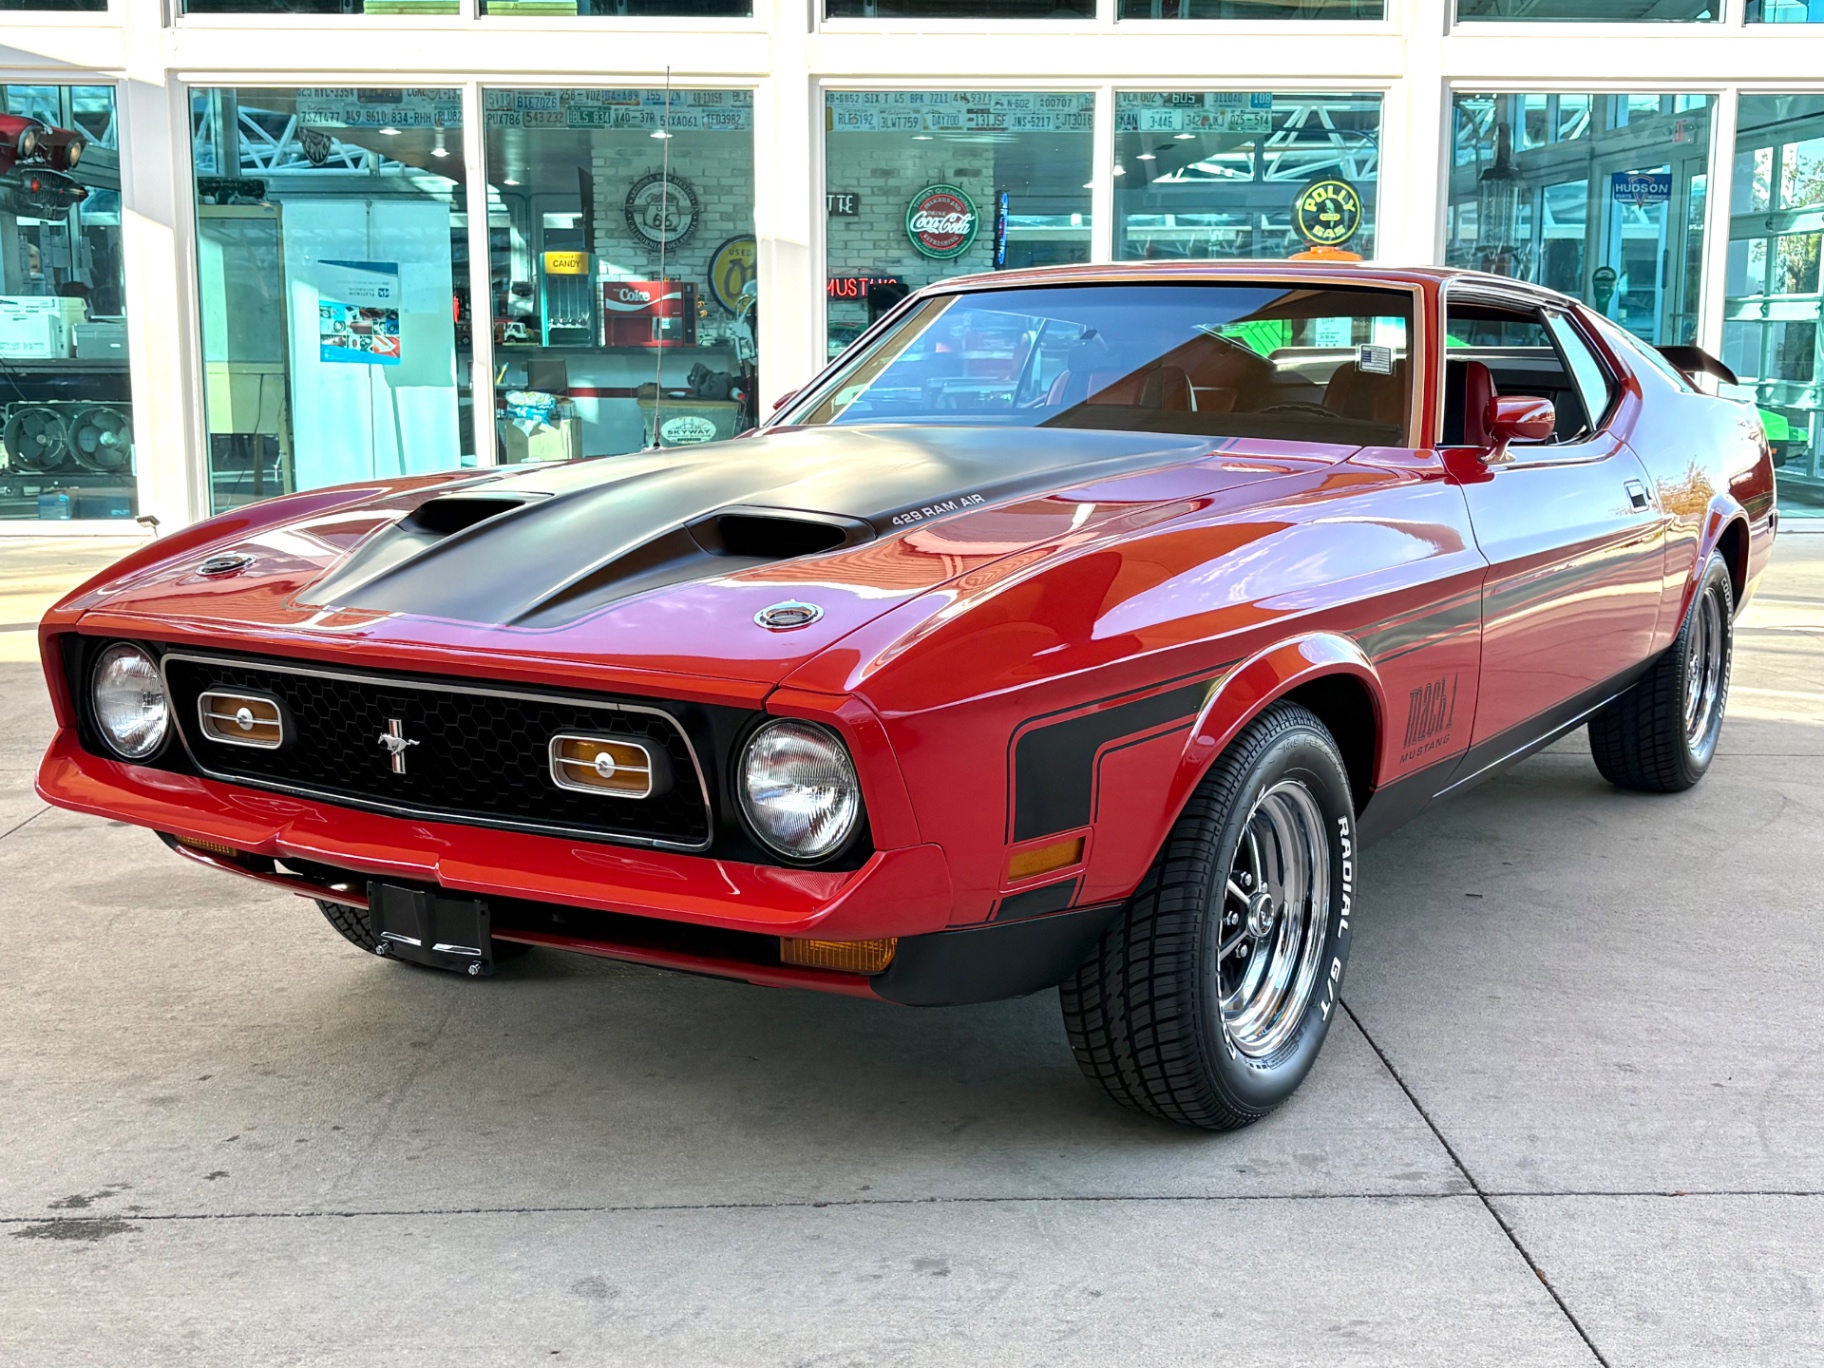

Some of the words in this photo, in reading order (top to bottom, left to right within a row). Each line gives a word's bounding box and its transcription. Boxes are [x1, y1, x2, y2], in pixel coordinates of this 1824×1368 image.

[1615, 183, 1669, 193] HUDSON
[1303, 185, 1356, 213] POLLY
[653, 213, 673, 228] 66
[1312, 224, 1346, 239] GAS
[728, 248, 753, 257] USED
[552, 259, 581, 268] CANDY
[619, 287, 652, 302] Coke
[892, 511, 924, 526] 429
[921, 500, 959, 518] RAM
[960, 493, 986, 508] AIR
[1400, 733, 1451, 764] MUSTANG
[1337, 815, 1353, 940] RADIAL
[1319, 956, 1343, 1022] G/T
